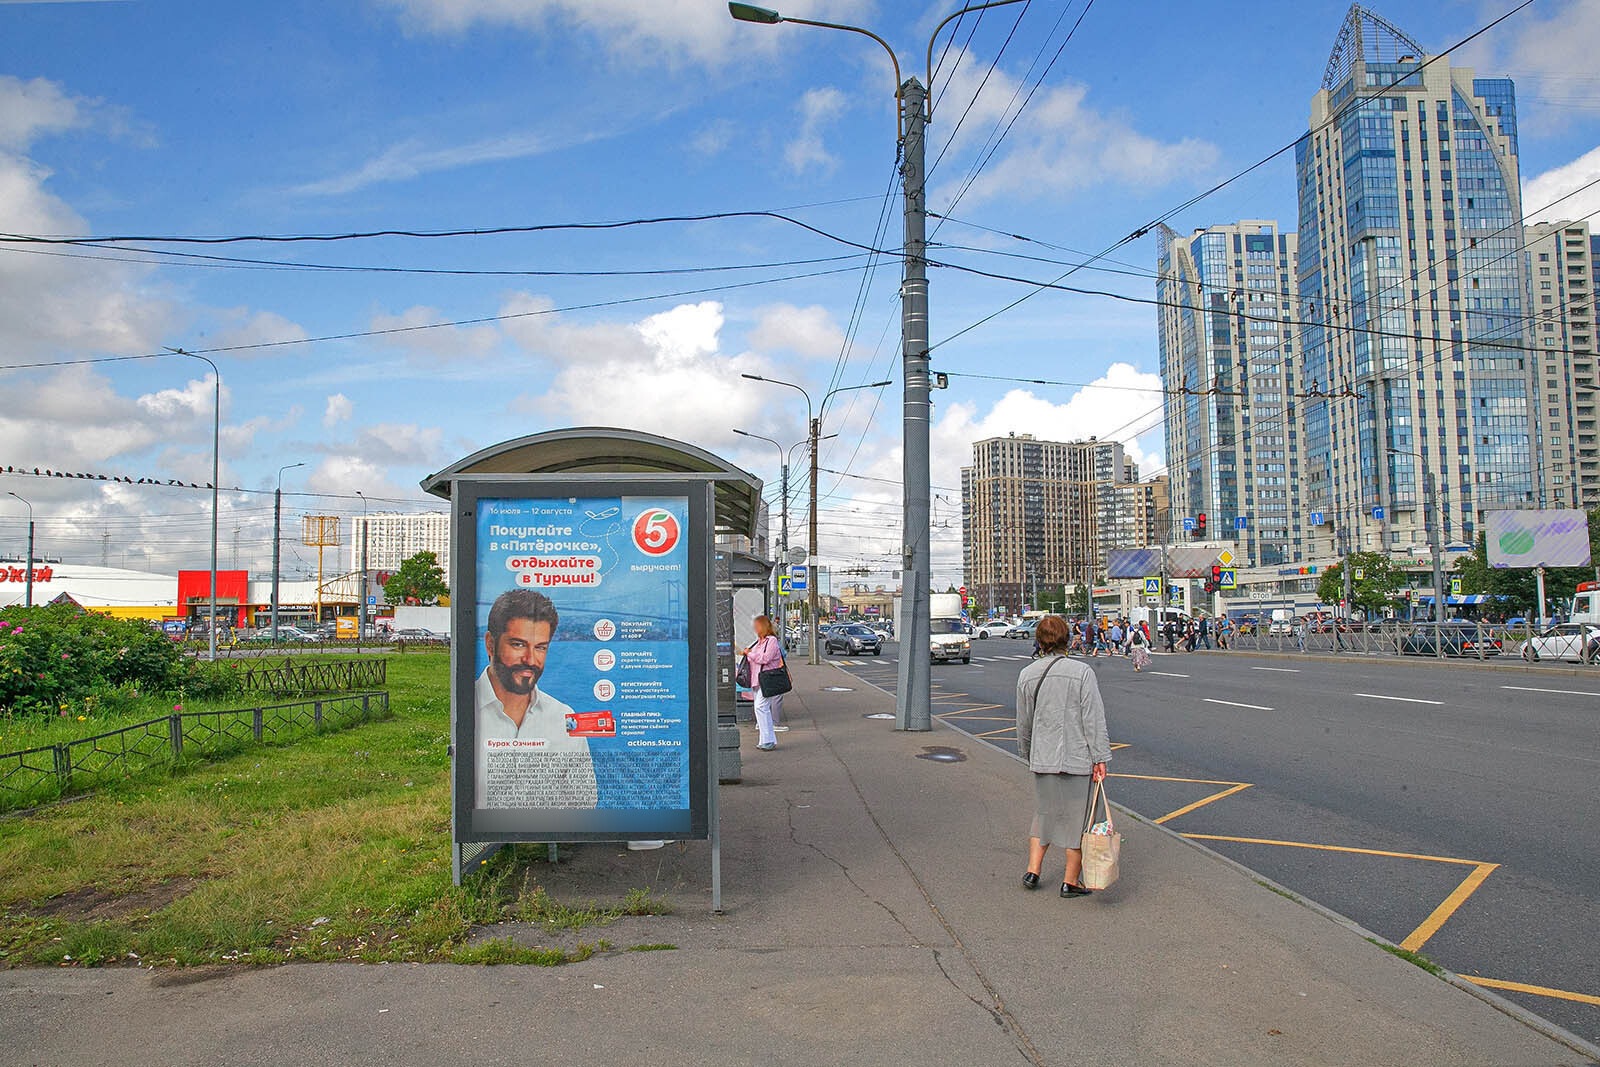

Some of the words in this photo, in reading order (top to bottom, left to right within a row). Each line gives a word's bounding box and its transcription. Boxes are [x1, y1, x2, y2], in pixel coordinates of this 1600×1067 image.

[541, 508, 573, 517] августа
[490, 525, 573, 539] Покупайте
[644, 513, 670, 548] 5
[489, 543, 498, 551] в
[501, 539, 602, 553] «Пятёрочке»,
[511, 556, 594, 569] отдыхайте
[630, 564, 681, 572] выручает!
[523, 574, 531, 583] в
[534, 572, 595, 586] Турции!
[487, 740, 510, 748] Бурак
